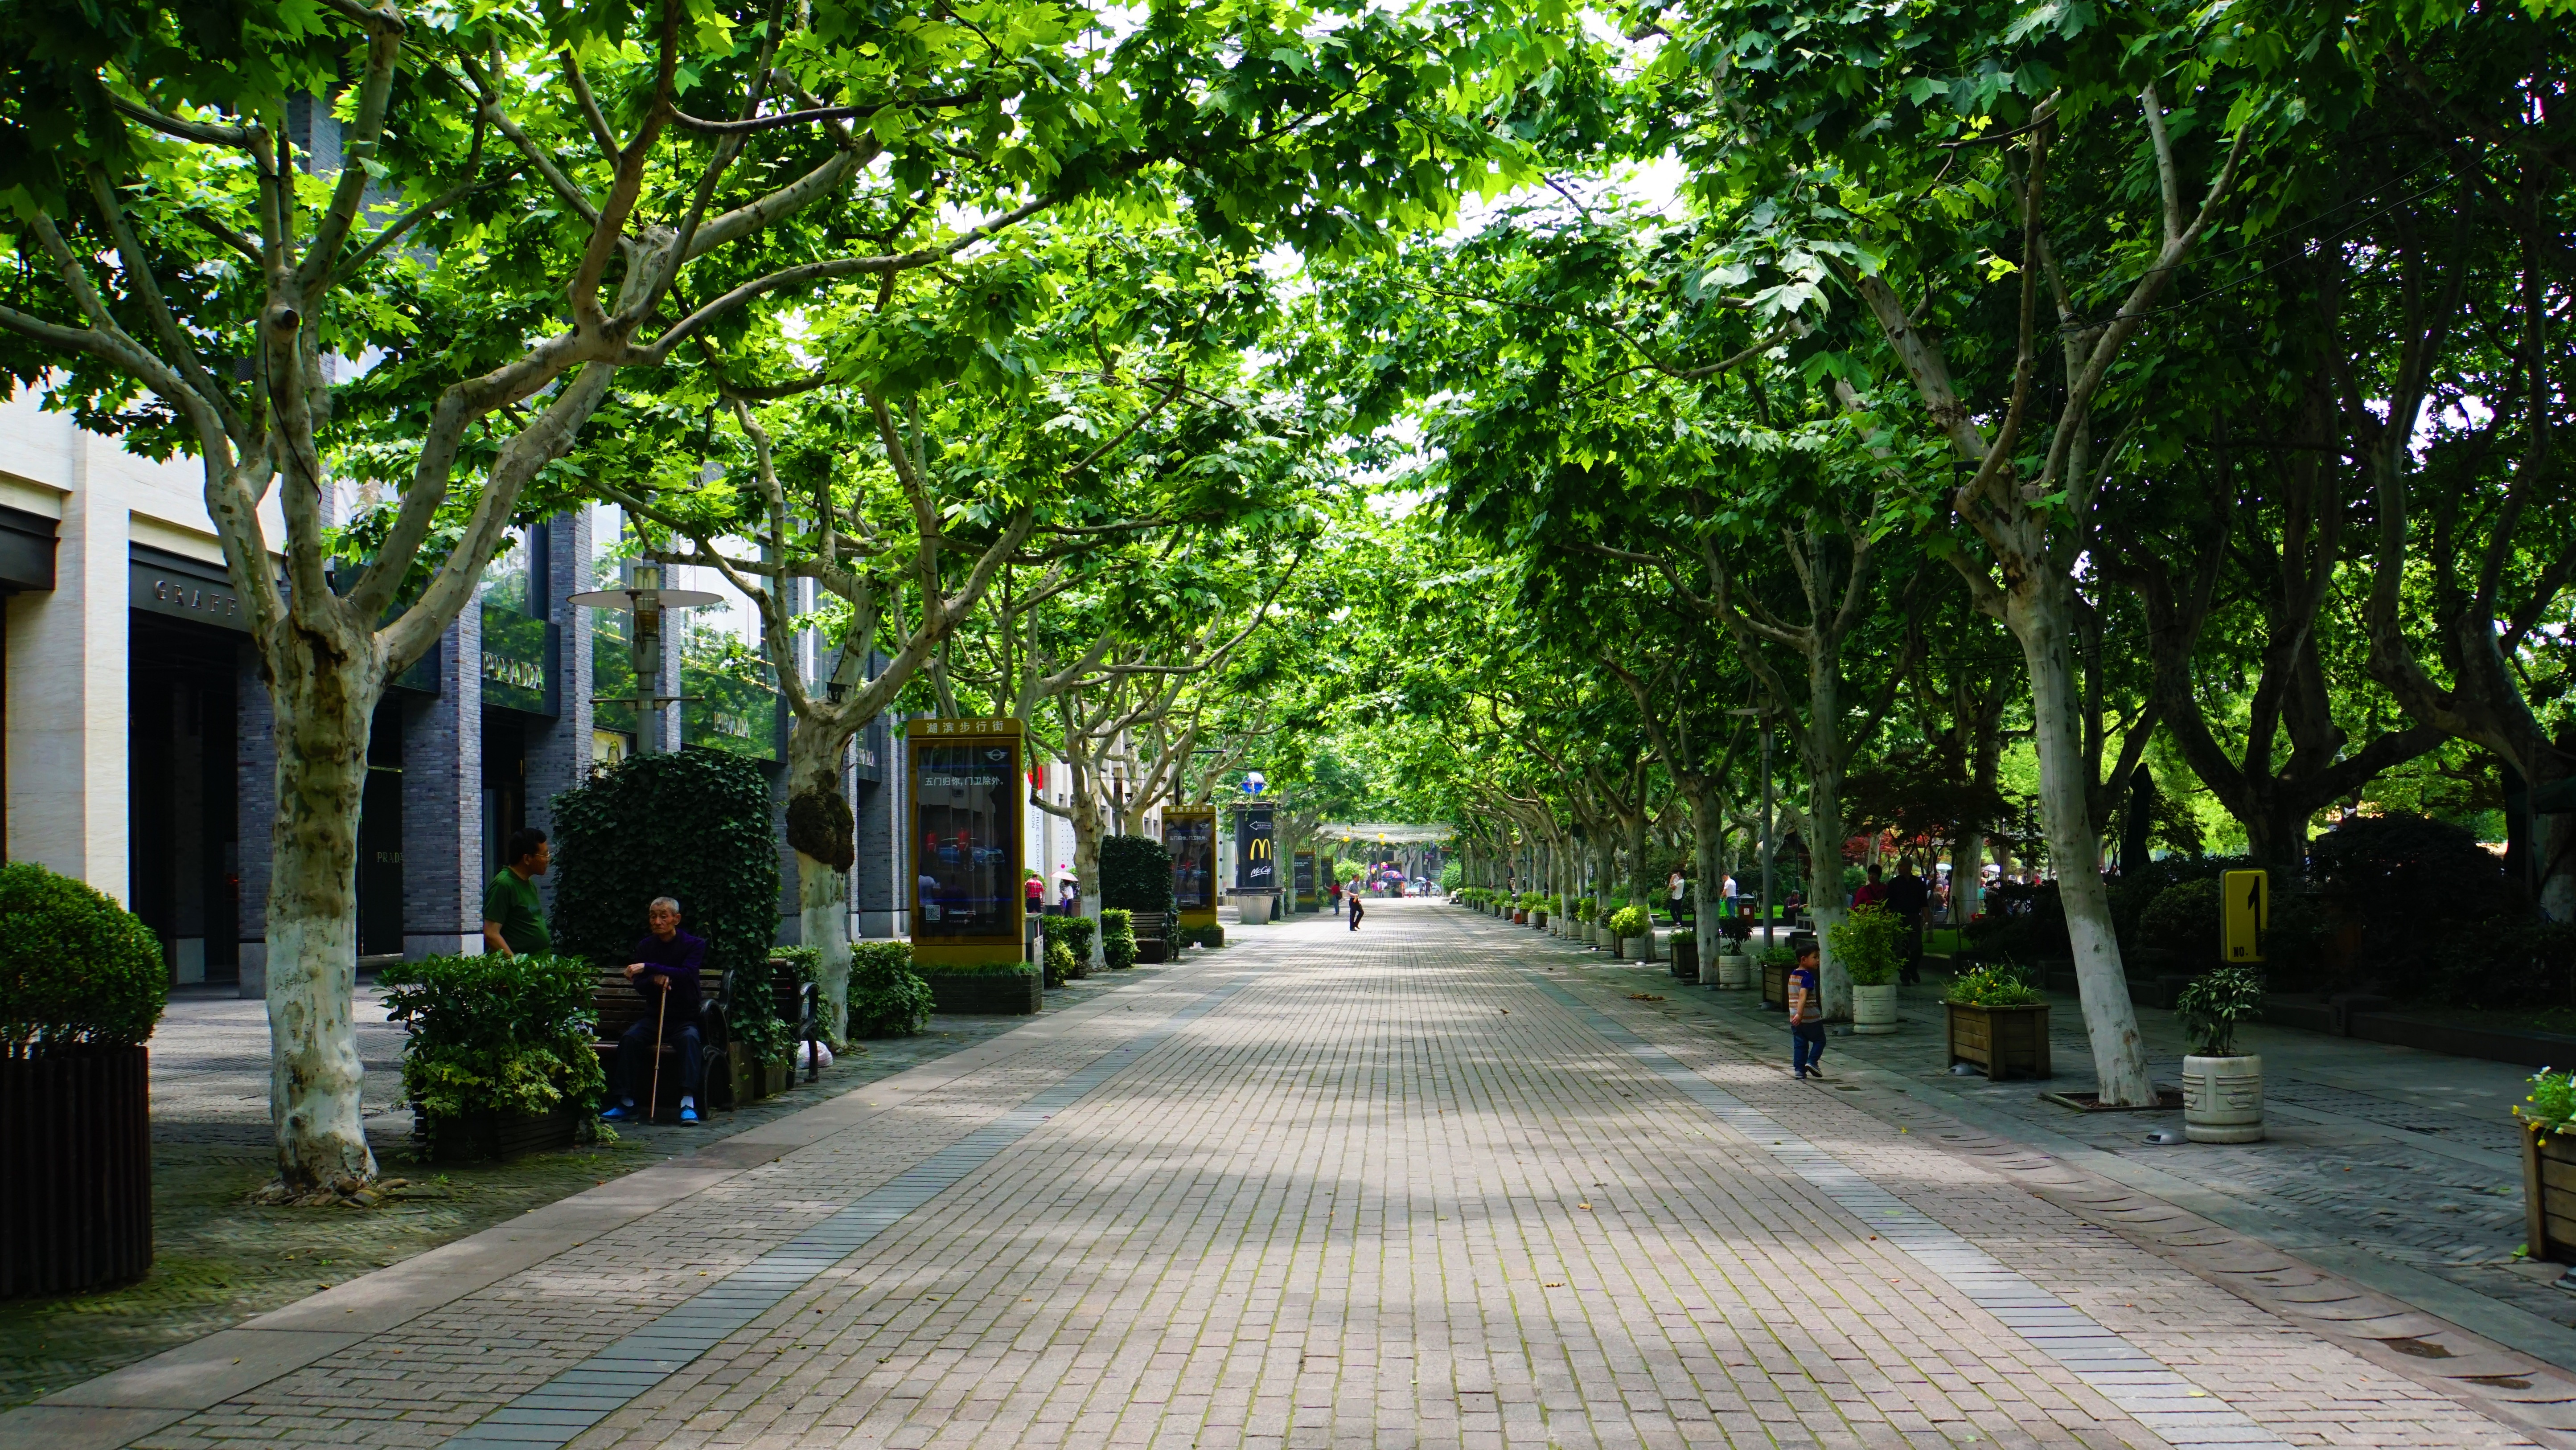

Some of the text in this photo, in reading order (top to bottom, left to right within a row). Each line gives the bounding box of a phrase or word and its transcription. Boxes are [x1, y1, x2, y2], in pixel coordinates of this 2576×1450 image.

[156, 580, 236, 615] GRAFF
[481, 651, 546, 691] PRADA
[713, 711, 750, 738] PRADA
[926, 721, 1004, 734] 湖滨步行街
[2234, 946, 2248, 957] NO.
